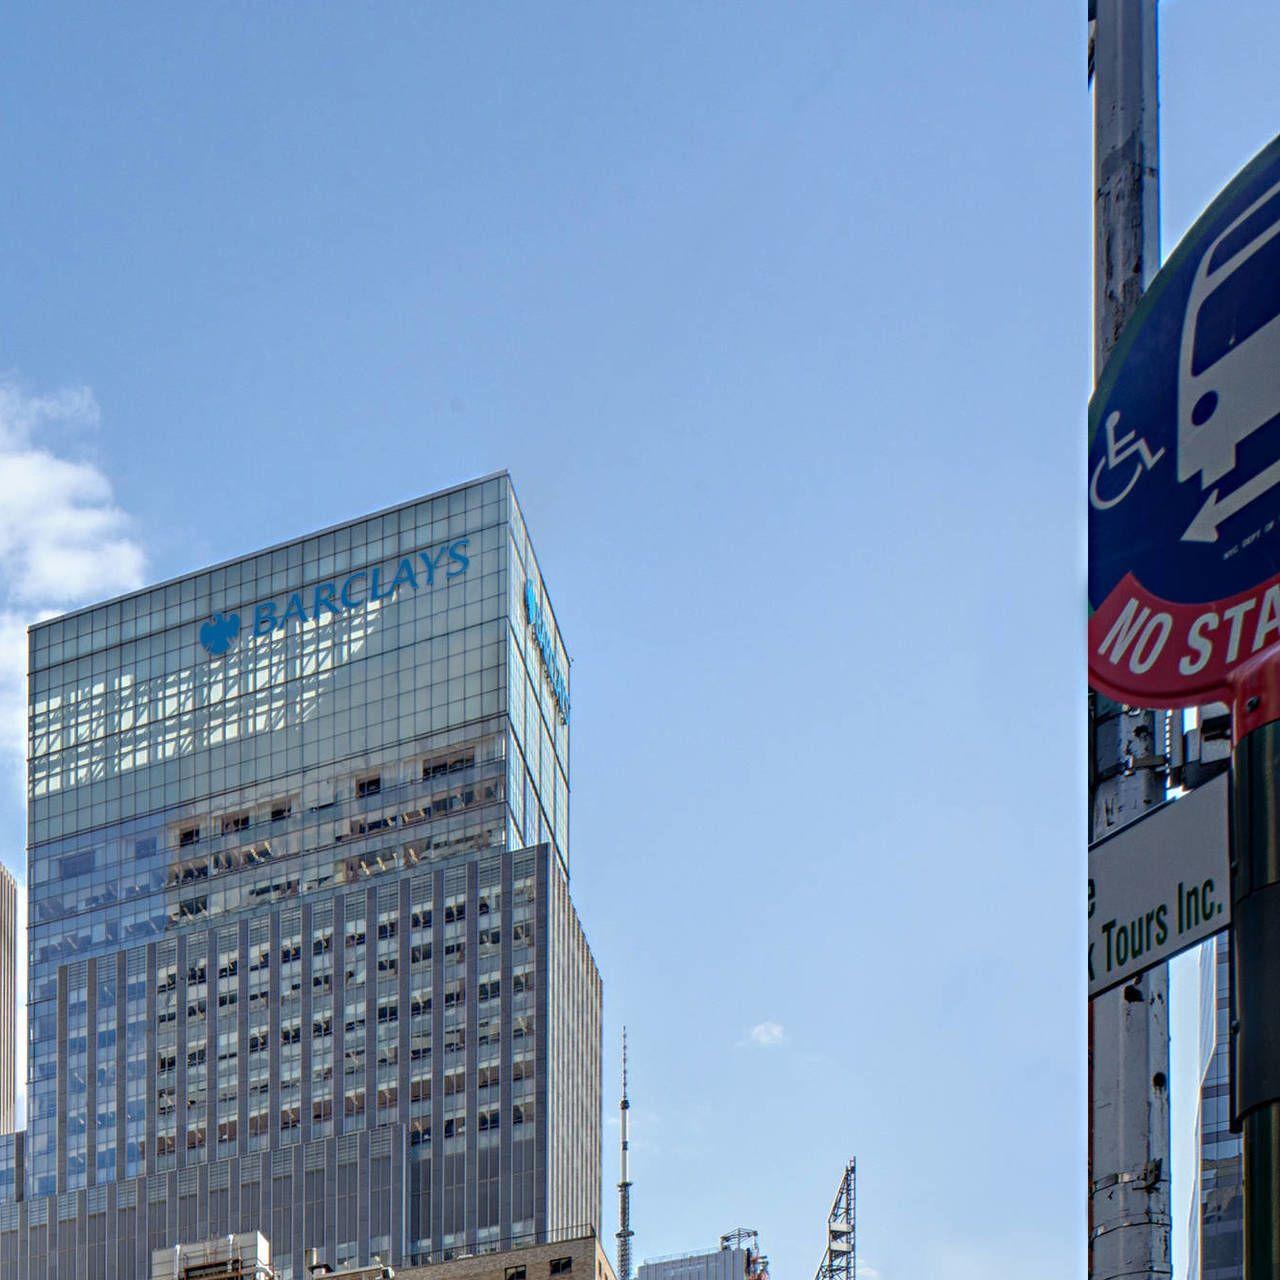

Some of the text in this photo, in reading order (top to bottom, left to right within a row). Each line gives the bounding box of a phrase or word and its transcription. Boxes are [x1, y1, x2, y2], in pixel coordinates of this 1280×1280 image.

[252, 538, 471, 638] BARCLAYS
[1097, 597, 1173, 675] NO
[1102, 918, 1168, 973] Tours
[1177, 878, 1223, 935] Inc.
